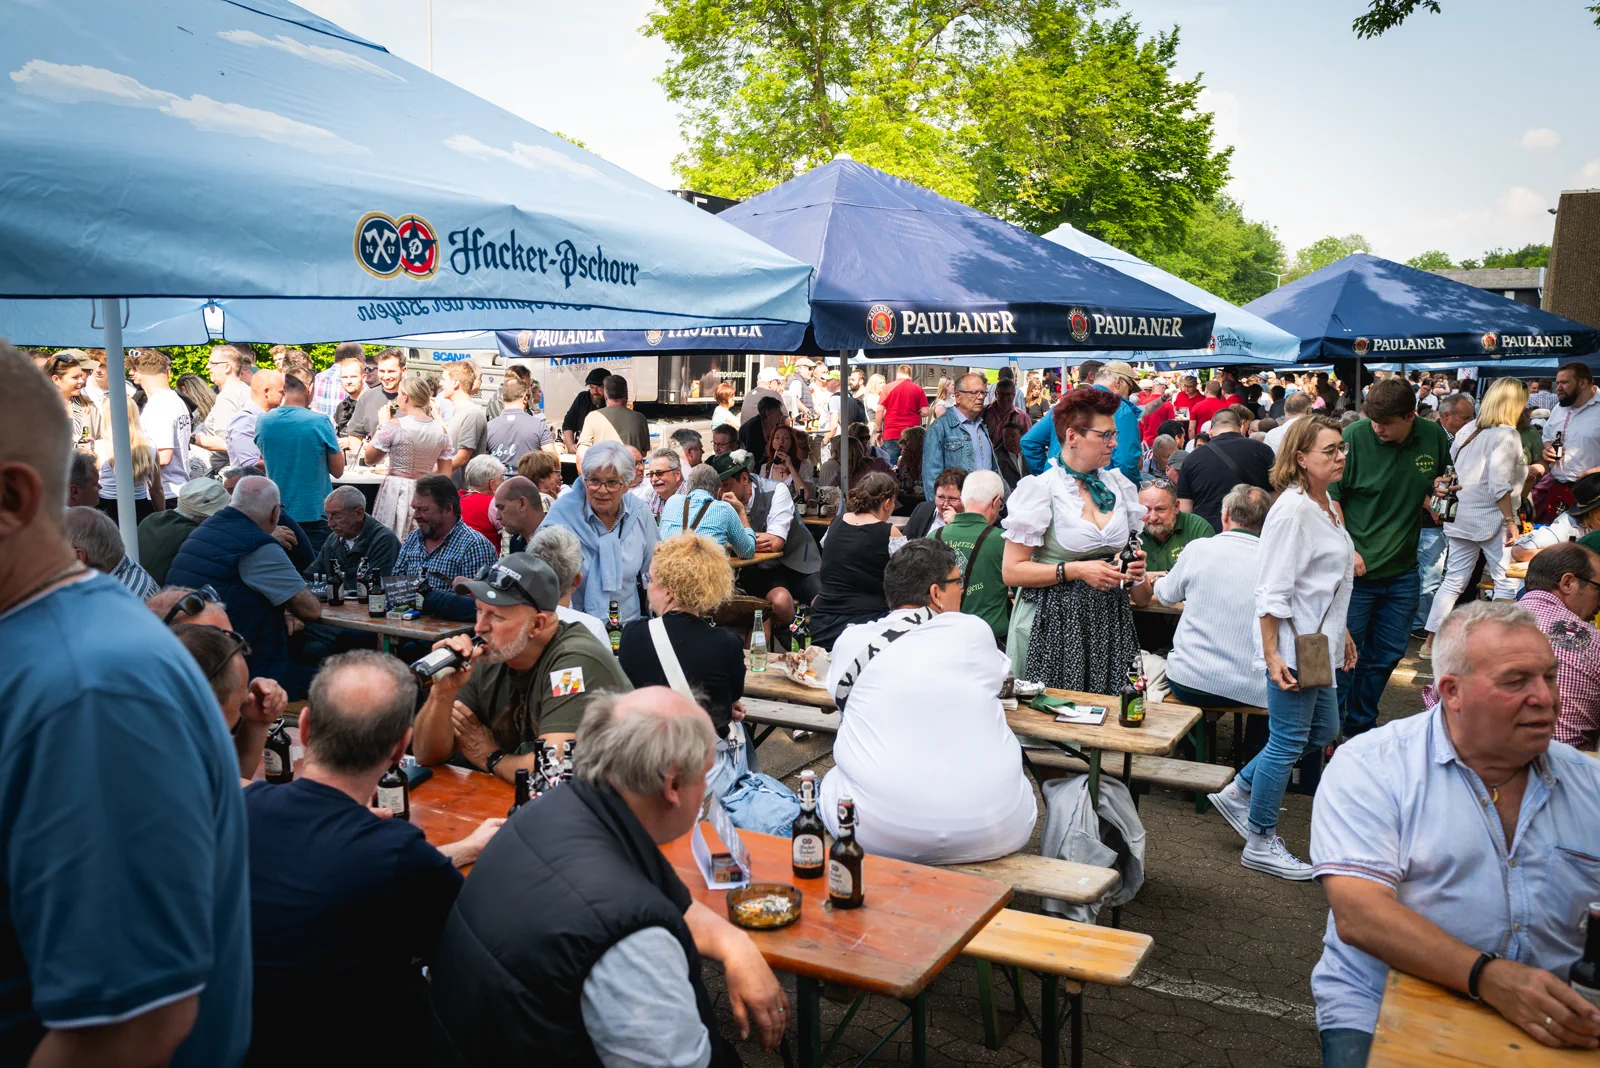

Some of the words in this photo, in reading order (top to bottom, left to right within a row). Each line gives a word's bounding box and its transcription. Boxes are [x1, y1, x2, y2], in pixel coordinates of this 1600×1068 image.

[365, 245, 374, 254] 14
[387, 245, 395, 254] 17
[448, 227, 640, 289] Hacker-Pschorr
[900, 310, 1017, 336] PAULANER
[1092, 313, 1184, 338] PAULANER
[1372, 336, 1447, 352] PAULANER
[1501, 334, 1574, 348] PAULANER
[712, 369, 746, 380] Temperature
